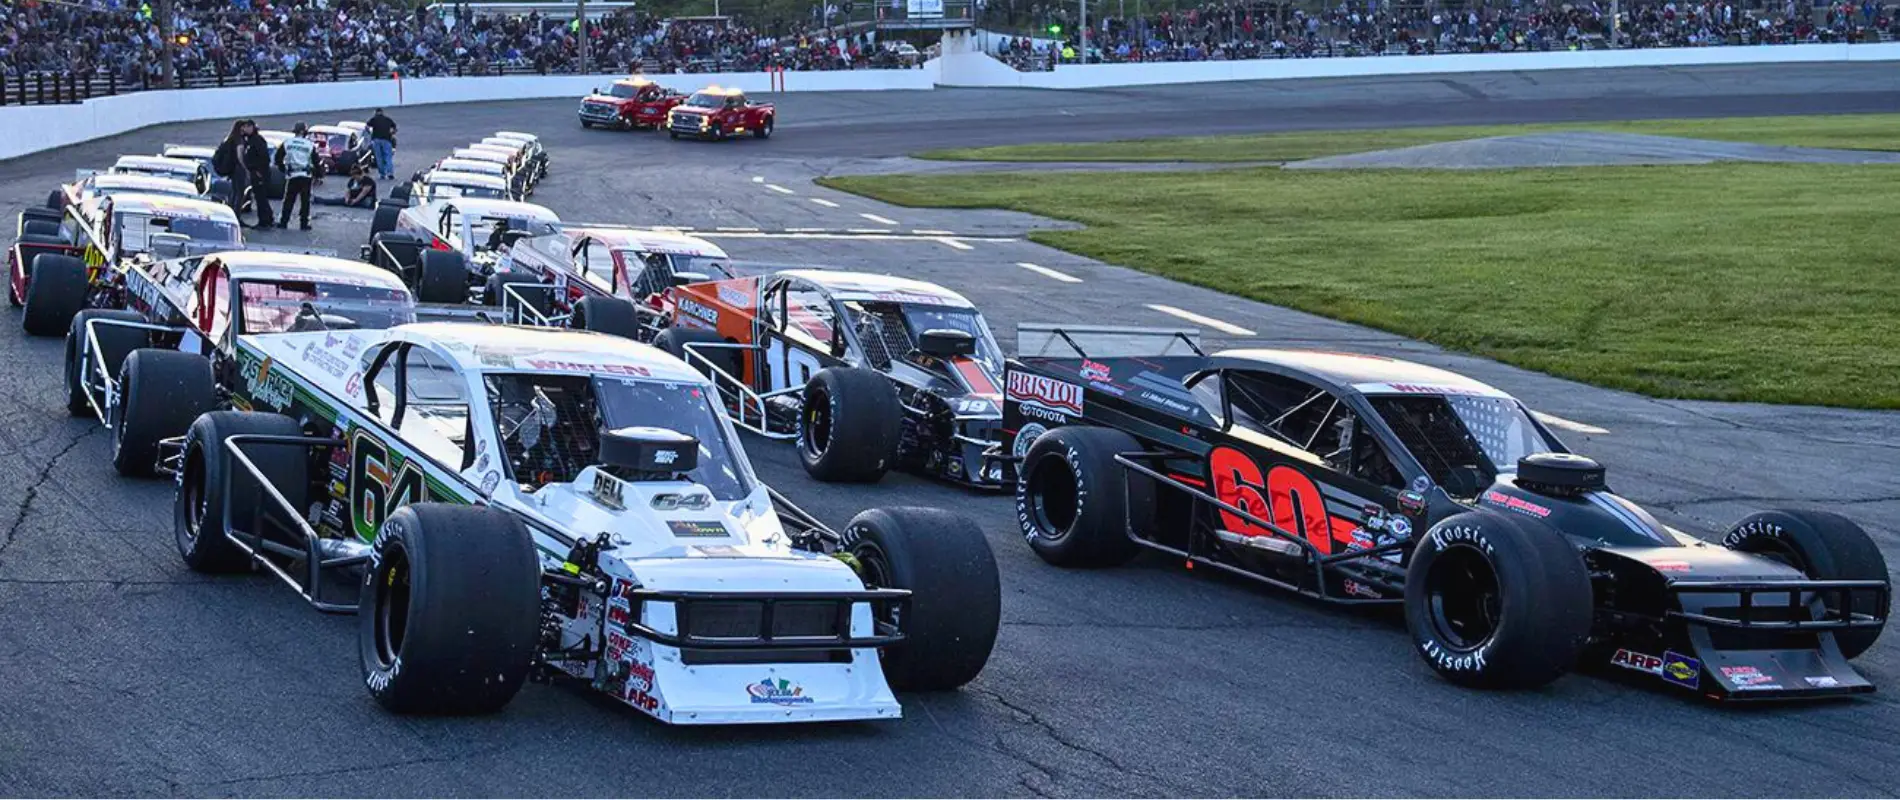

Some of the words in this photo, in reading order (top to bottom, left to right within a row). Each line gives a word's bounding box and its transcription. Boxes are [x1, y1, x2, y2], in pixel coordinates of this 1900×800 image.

[525, 357, 652, 377] WHELEN
[1008, 371, 1083, 408] BRISTOL
[958, 400, 989, 412] 19
[1031, 407, 1067, 425] TOYOTA
[592, 471, 624, 500] DELL
[651, 492, 711, 511] 64
[1210, 446, 1332, 556] 60
[1431, 526, 1494, 557] Hoosier
[1421, 639, 1487, 672] Hoosier
[1616, 649, 1662, 670] ARP
[628, 687, 659, 711] ARP
